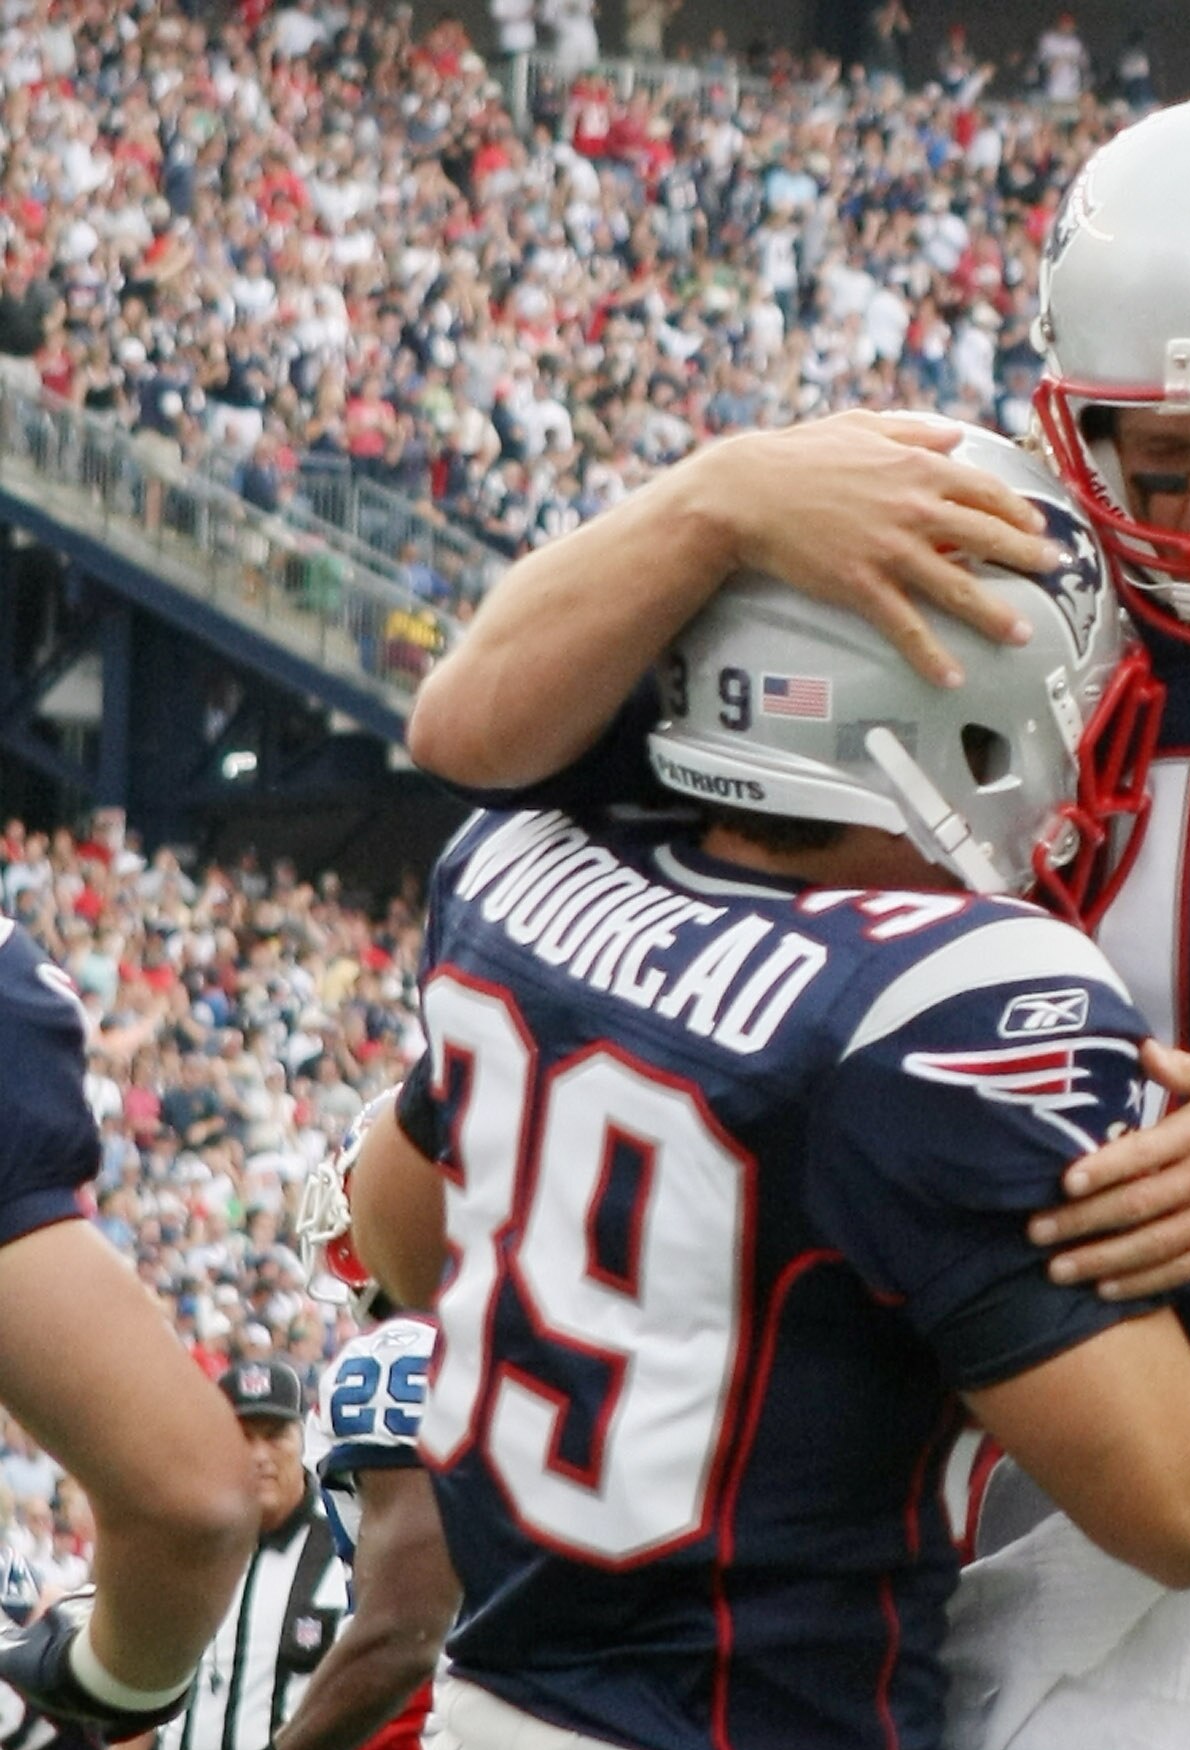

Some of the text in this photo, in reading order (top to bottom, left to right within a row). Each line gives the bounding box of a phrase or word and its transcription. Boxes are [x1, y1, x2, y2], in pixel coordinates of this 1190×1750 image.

[656, 753, 765, 801] PATRIOTS
[455, 808, 828, 1055] WOODHEAD
[417, 963, 759, 1573] 39
